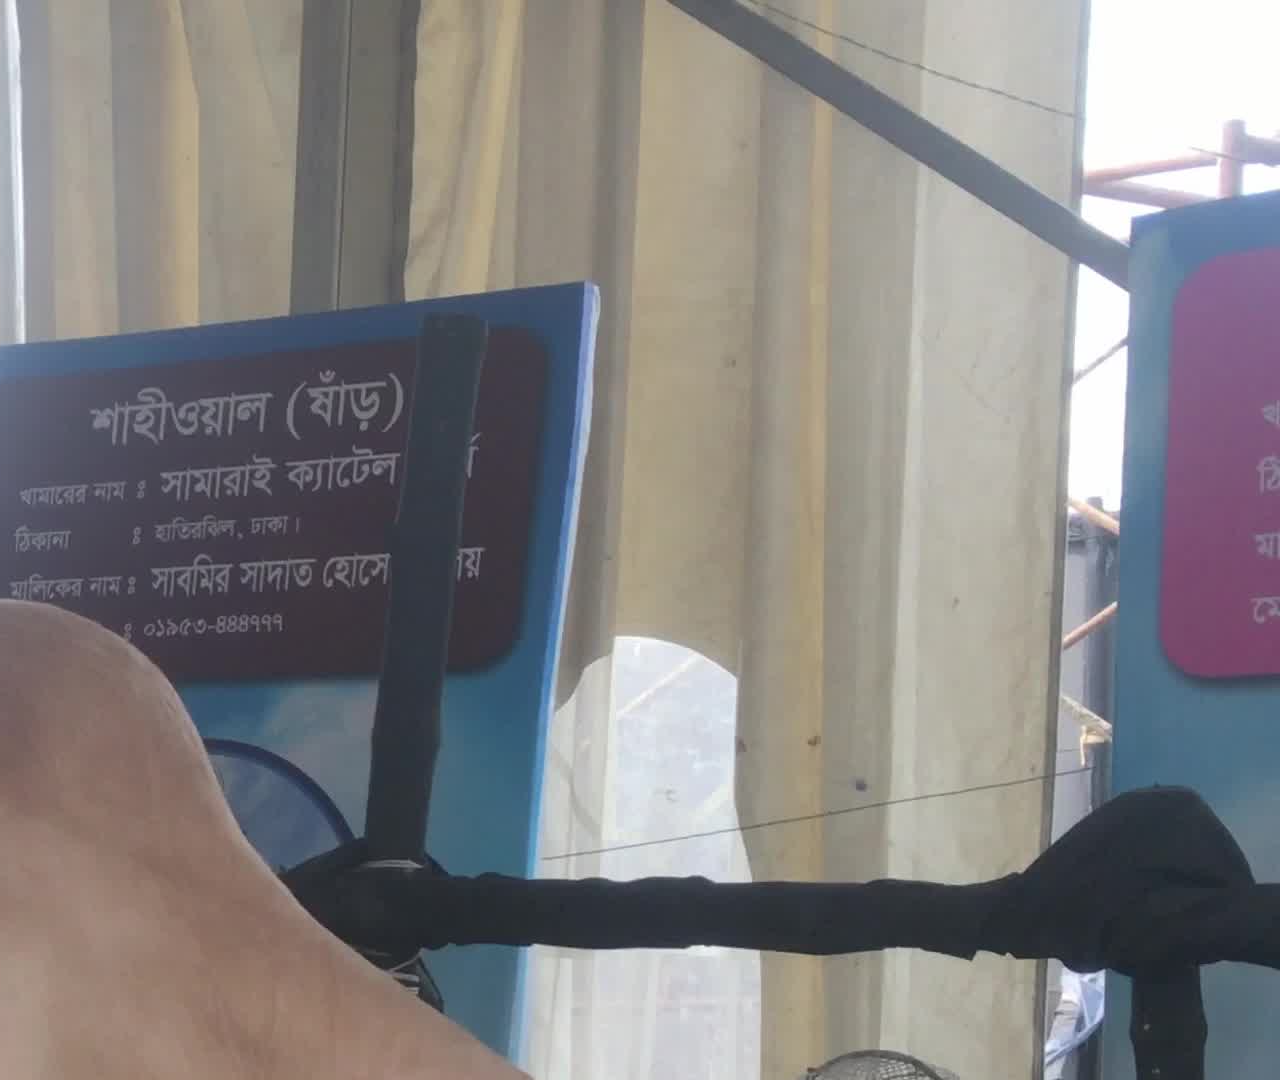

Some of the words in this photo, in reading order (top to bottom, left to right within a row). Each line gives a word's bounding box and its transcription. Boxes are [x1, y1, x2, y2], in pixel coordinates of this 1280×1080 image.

[90, 387, 273, 446] শাহীওয়াল
[286, 369, 404, 441] (ষাঁড়)
[160, 454, 278, 501] সামারাই
[286, 444, 401, 492] ক্যাটেল
[13, 523, 72, 553] ঠিকানা
[239, 558, 317, 593] সাদাত
